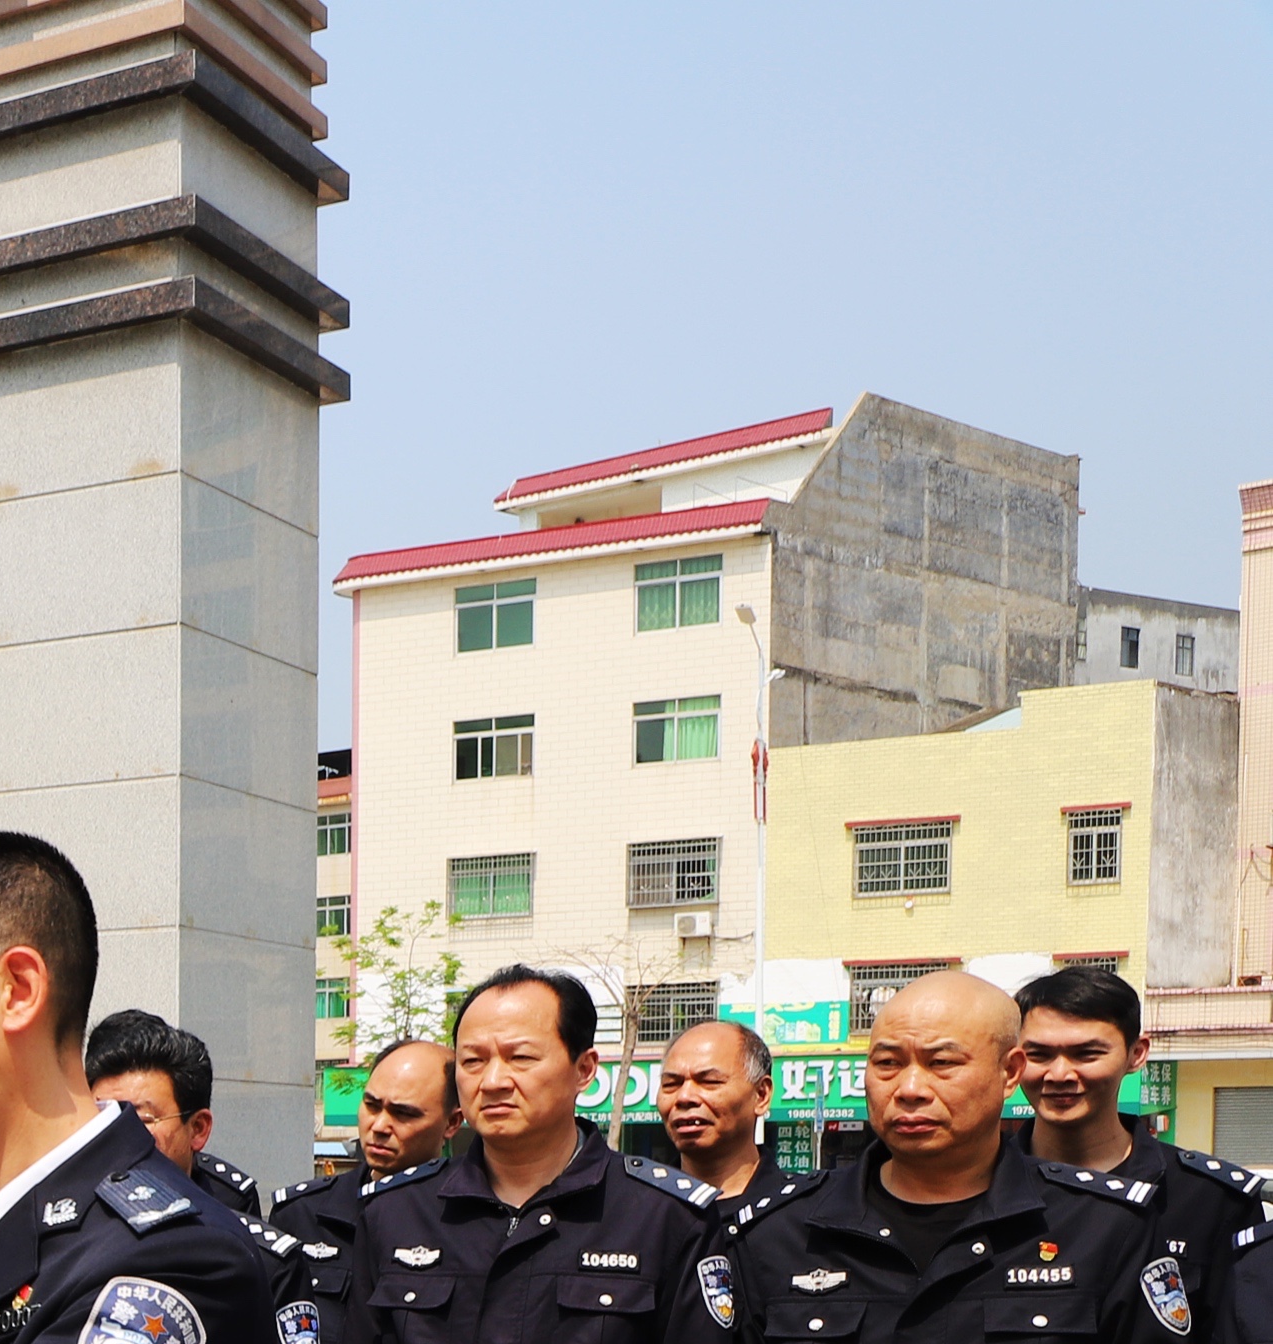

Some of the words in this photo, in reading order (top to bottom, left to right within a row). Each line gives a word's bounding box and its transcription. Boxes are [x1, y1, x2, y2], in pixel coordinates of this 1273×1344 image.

[778, 1126, 810, 1138] 四轮
[777, 1141, 810, 1154] 定位
[777, 1156, 809, 1169] 机油
[581, 1252, 638, 1269] 104650
[1007, 1266, 1072, 1284] 104455
